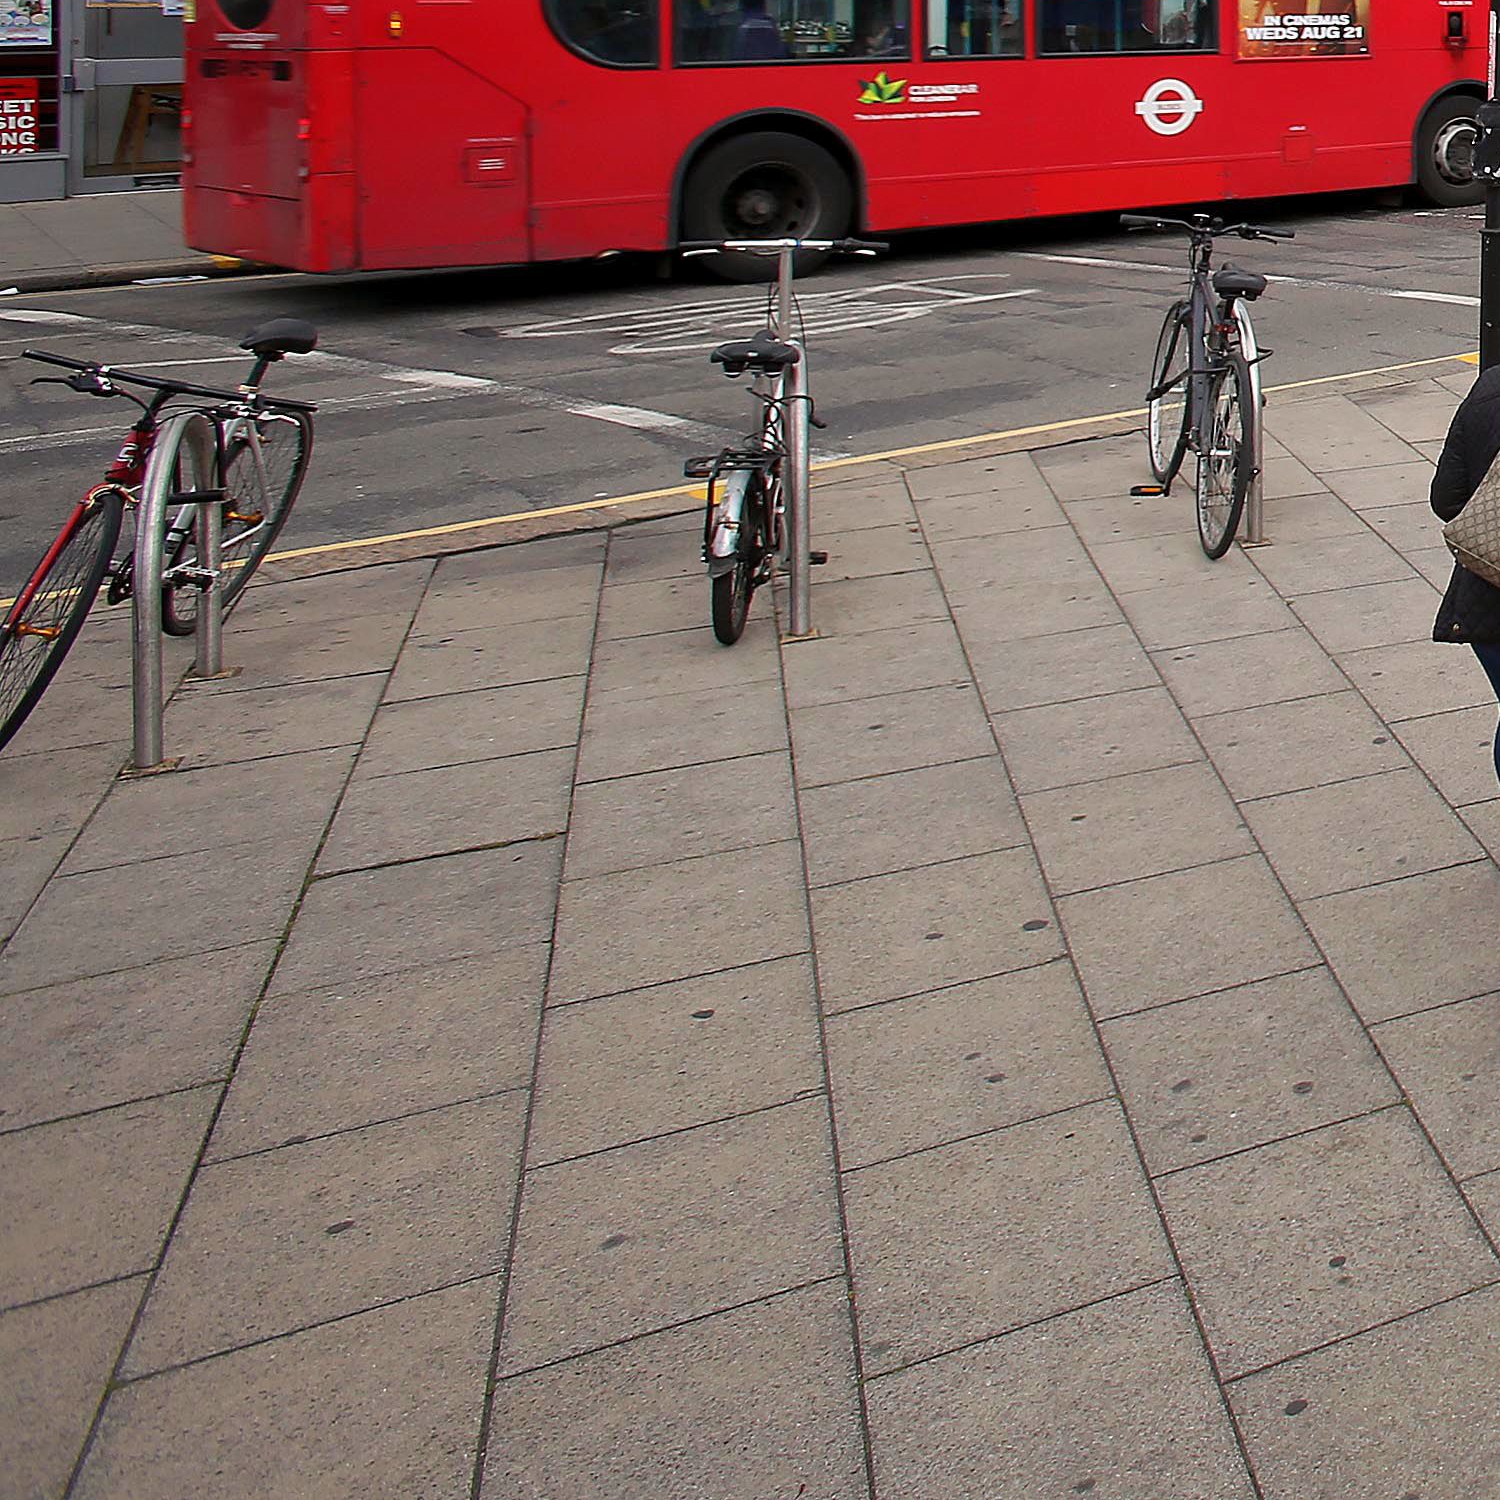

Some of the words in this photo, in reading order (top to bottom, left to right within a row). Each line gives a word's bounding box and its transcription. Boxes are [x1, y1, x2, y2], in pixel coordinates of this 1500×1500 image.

[1263, 15, 1281, 26] IN
[1282, 14, 1351, 26] CINEMAS
[1245, 27, 1299, 40] WEDS
[1300, 26, 1341, 39] AUG
[1342, 26, 1363, 39] 21
[0, 132, 36, 146] NG
